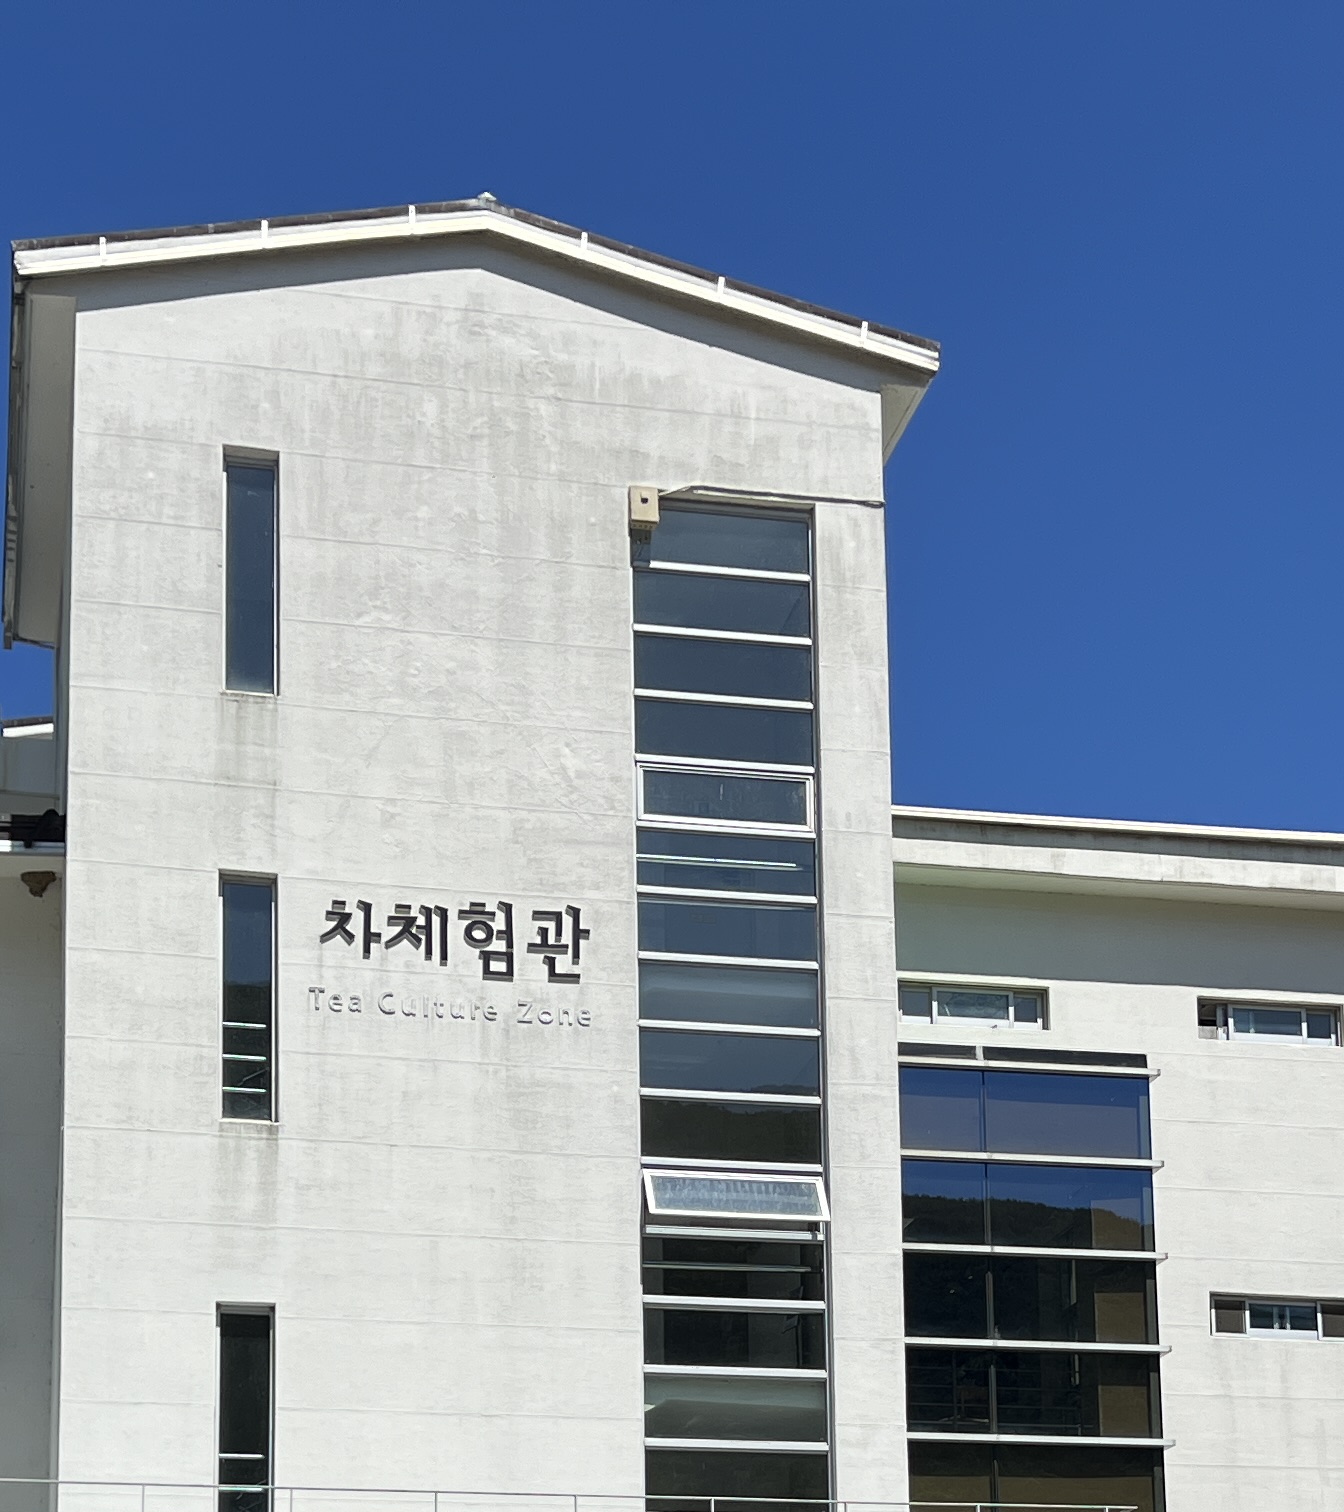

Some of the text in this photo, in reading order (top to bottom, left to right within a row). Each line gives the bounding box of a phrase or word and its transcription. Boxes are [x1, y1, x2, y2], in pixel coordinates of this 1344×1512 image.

[319, 899, 590, 984] 차체험관
[308, 986, 591, 1027] Tea Culture Zone
